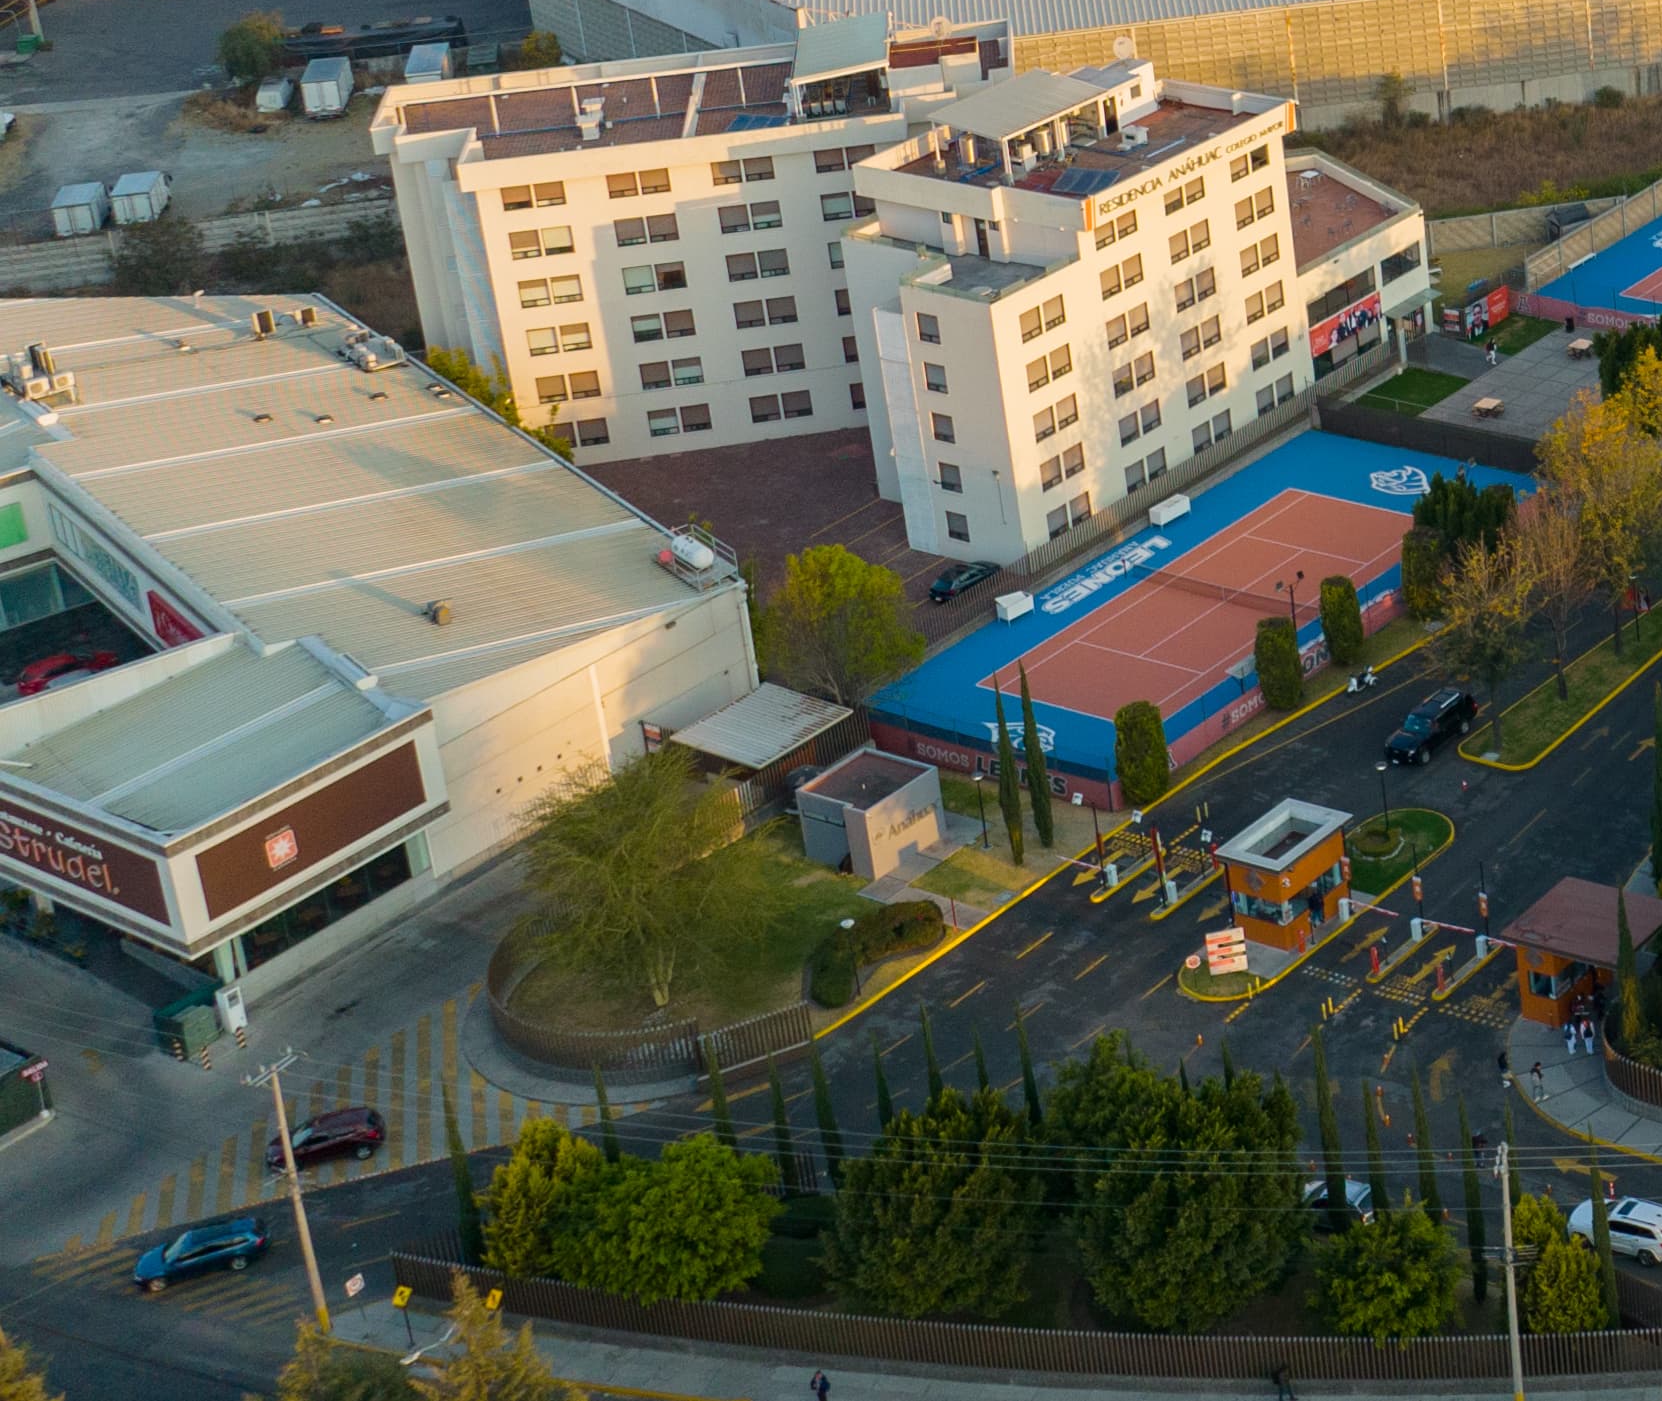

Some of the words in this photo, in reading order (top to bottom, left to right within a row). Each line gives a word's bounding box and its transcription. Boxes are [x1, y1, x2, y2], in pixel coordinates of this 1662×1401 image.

[1099, 177, 1163, 216] RESIDENCIA
[1167, 146, 1223, 183] ANÁHUAC
[1041, 535, 1173, 615] LEONES
[916, 742, 970, 768] SOMOS
